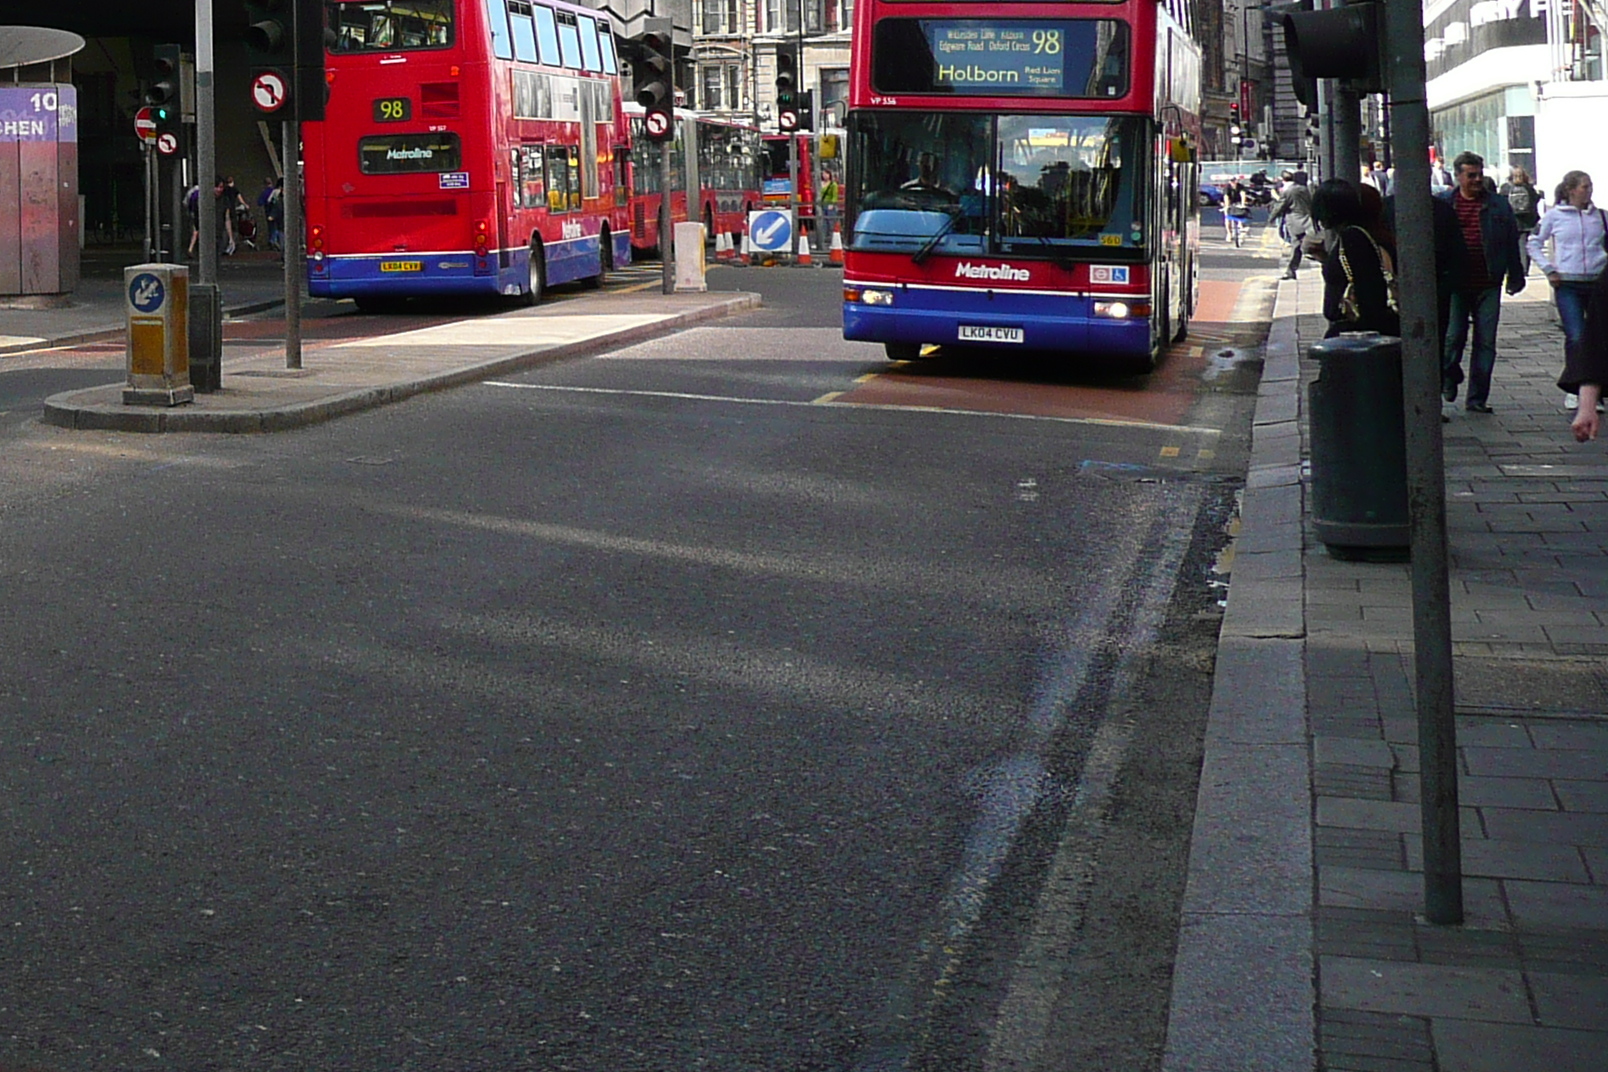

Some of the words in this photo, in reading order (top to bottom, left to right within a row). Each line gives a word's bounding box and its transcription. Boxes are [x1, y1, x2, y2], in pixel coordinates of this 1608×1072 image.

[939, 40, 966, 53] Edgware
[967, 40, 985, 51] Road
[1032, 29, 1061, 54] 98
[938, 64, 1019, 83] Holborn
[1024, 66, 1041, 75] Red
[1028, 75, 1057, 85] Square
[380, 100, 404, 119] 98
[386, 147, 433, 160] Metroline
[954, 261, 1031, 281] Metroline
[962, 328, 993, 340] LK04
[995, 329, 1019, 341] CVU
